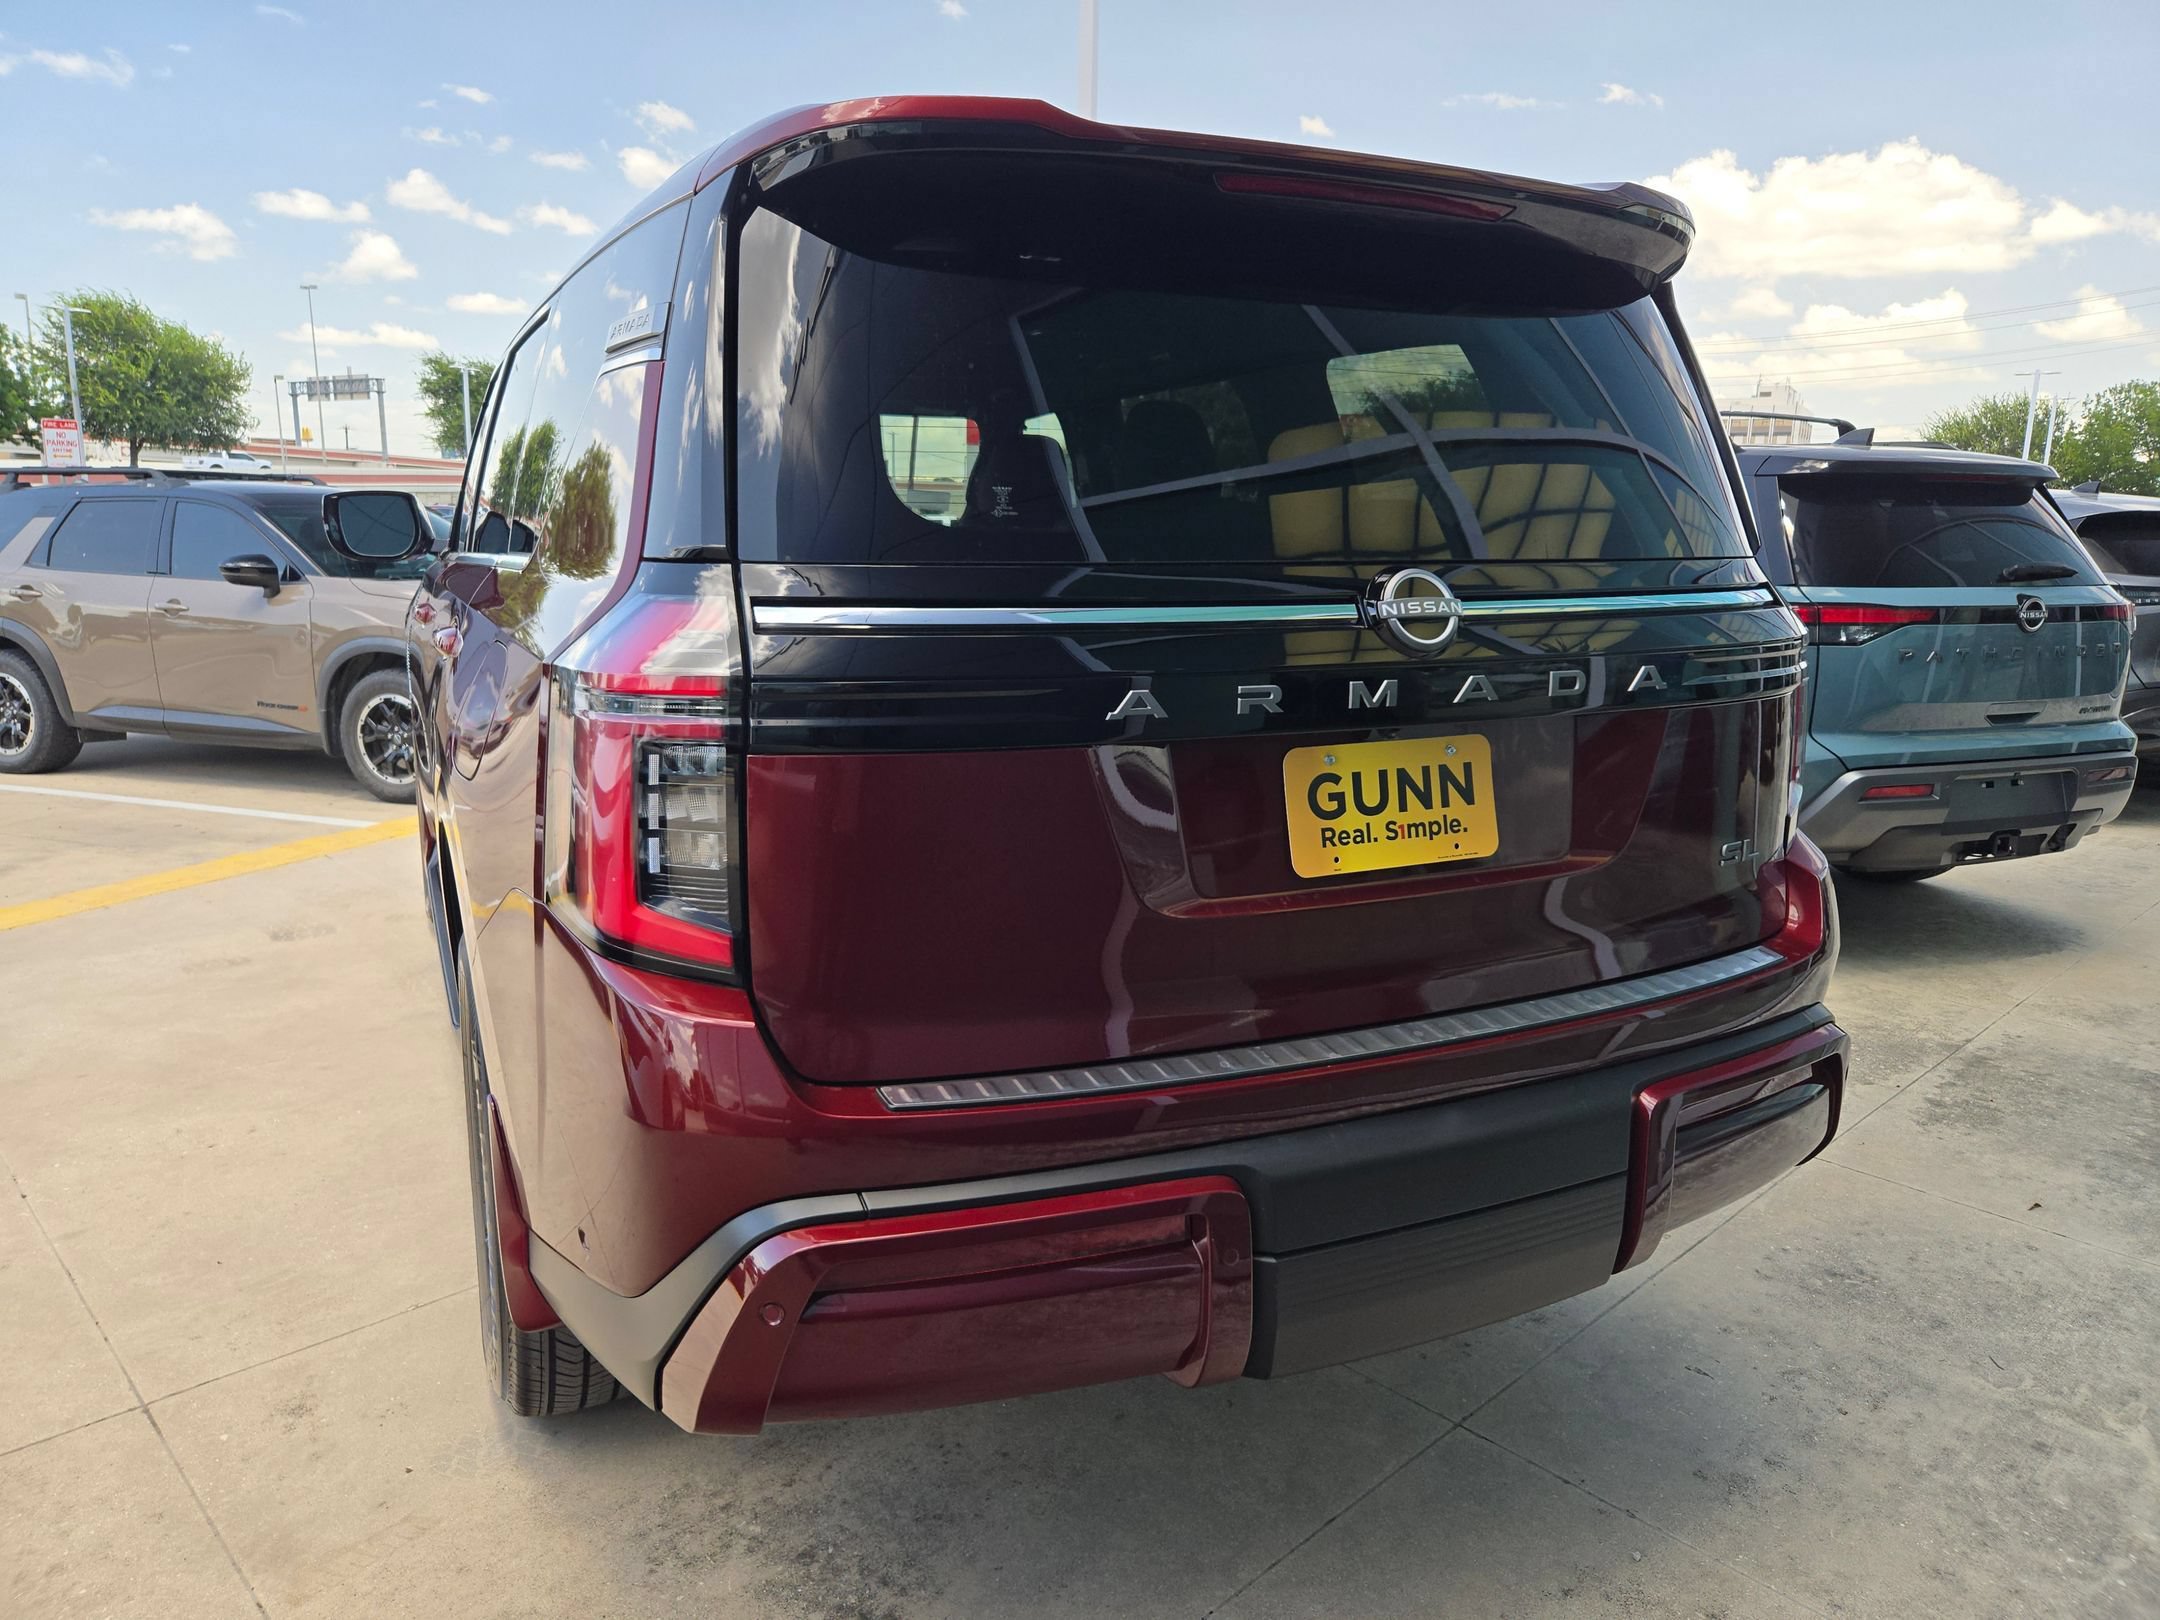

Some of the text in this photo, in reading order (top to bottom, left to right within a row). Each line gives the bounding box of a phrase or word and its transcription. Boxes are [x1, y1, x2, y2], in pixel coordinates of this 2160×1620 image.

[1381, 601, 1462, 616] NISSAN
[2019, 612, 2048, 620] NISSAN
[1899, 641, 2122, 663] PATHFINDER
[1106, 664, 1668, 721] ARMADA
[1307, 761, 1476, 821] GUNN
[1321, 822, 1379, 849] Real.
[1719, 838, 1760, 867] SL
